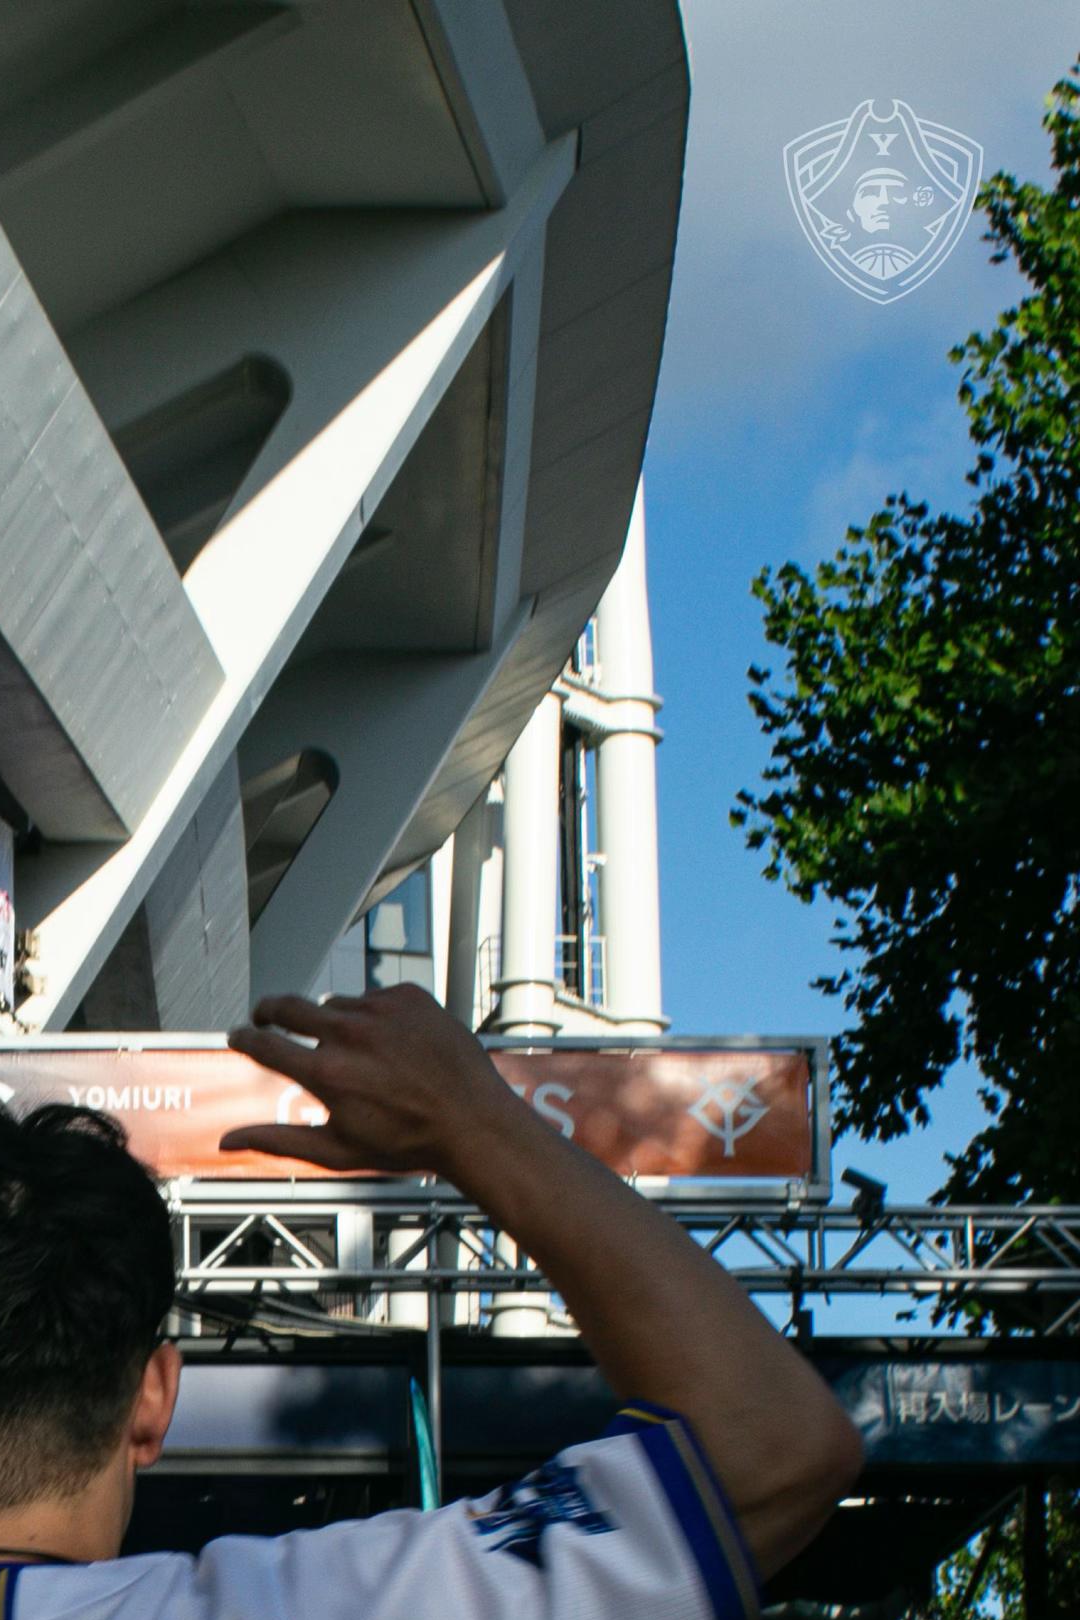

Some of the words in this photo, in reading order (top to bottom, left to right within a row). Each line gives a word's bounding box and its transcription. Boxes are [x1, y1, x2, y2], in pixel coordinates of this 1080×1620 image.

[67, 1085, 192, 1111] YOMIURI
[894, 1391, 1080, 1424] 再入場レーン
